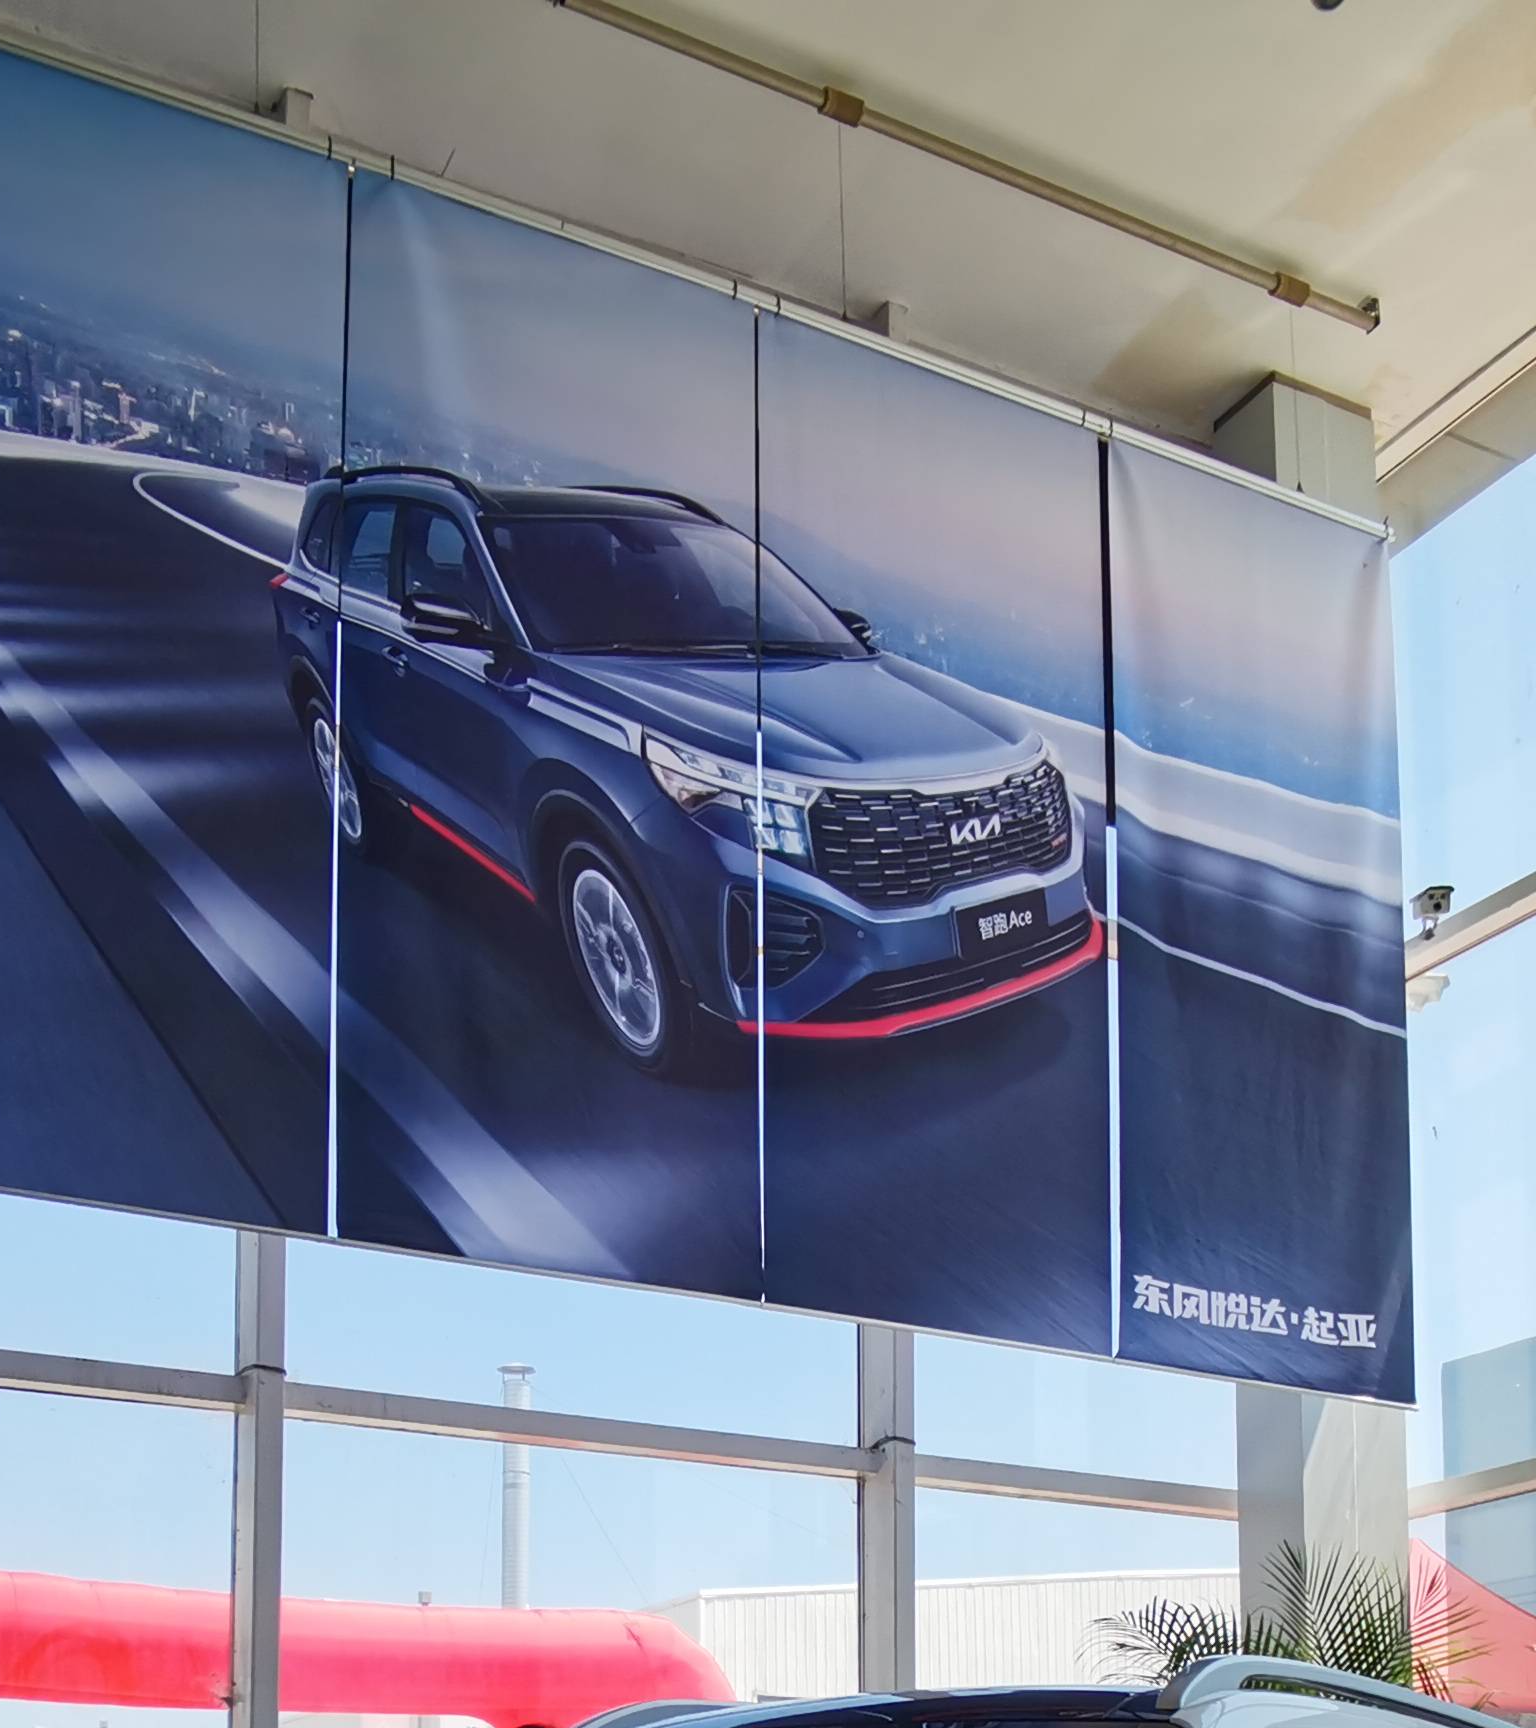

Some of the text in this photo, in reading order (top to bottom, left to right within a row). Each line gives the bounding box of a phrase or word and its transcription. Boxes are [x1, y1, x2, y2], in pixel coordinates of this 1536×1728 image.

[978, 910, 1032, 941] 智跑Ace
[1132, 1273, 1377, 1349] 东风悦达·起亚
